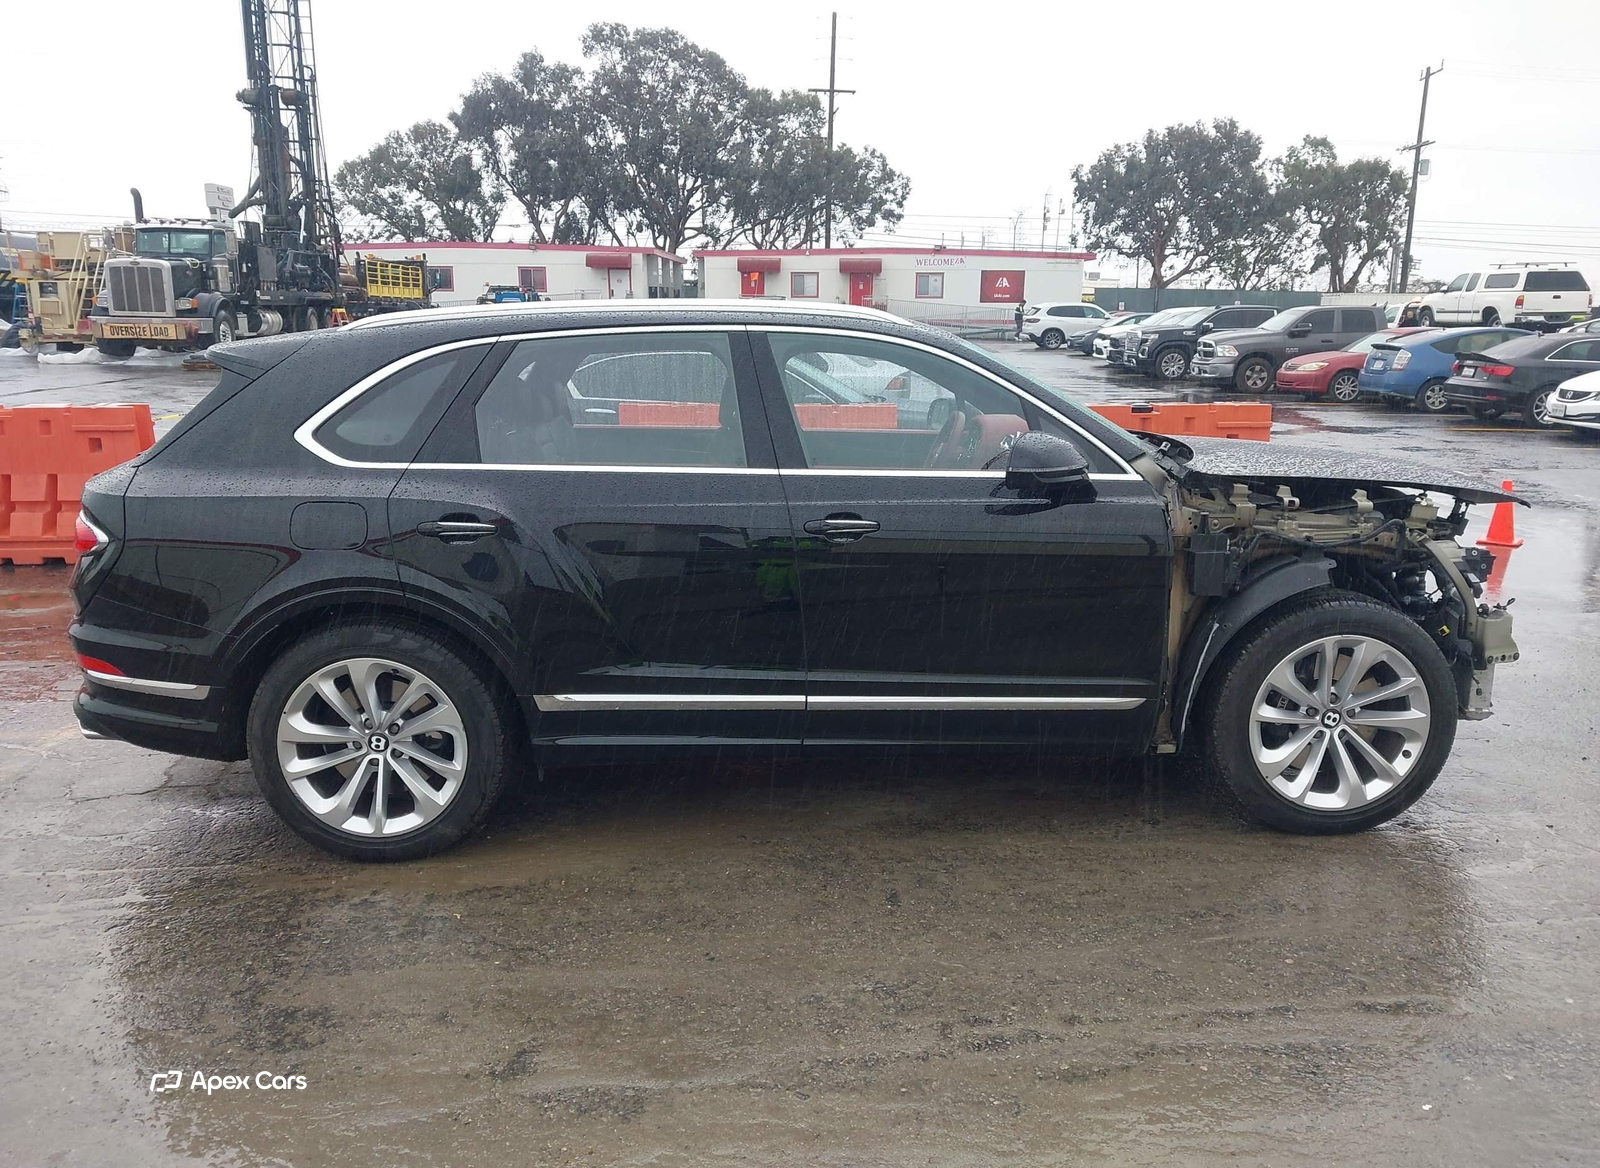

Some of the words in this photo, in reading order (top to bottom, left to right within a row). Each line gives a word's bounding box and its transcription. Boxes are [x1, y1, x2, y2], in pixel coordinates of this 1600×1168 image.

[916, 258, 955, 266] WELCOME
[109, 325, 147, 337] OVERSIZE
[149, 326, 169, 337] LOAD
